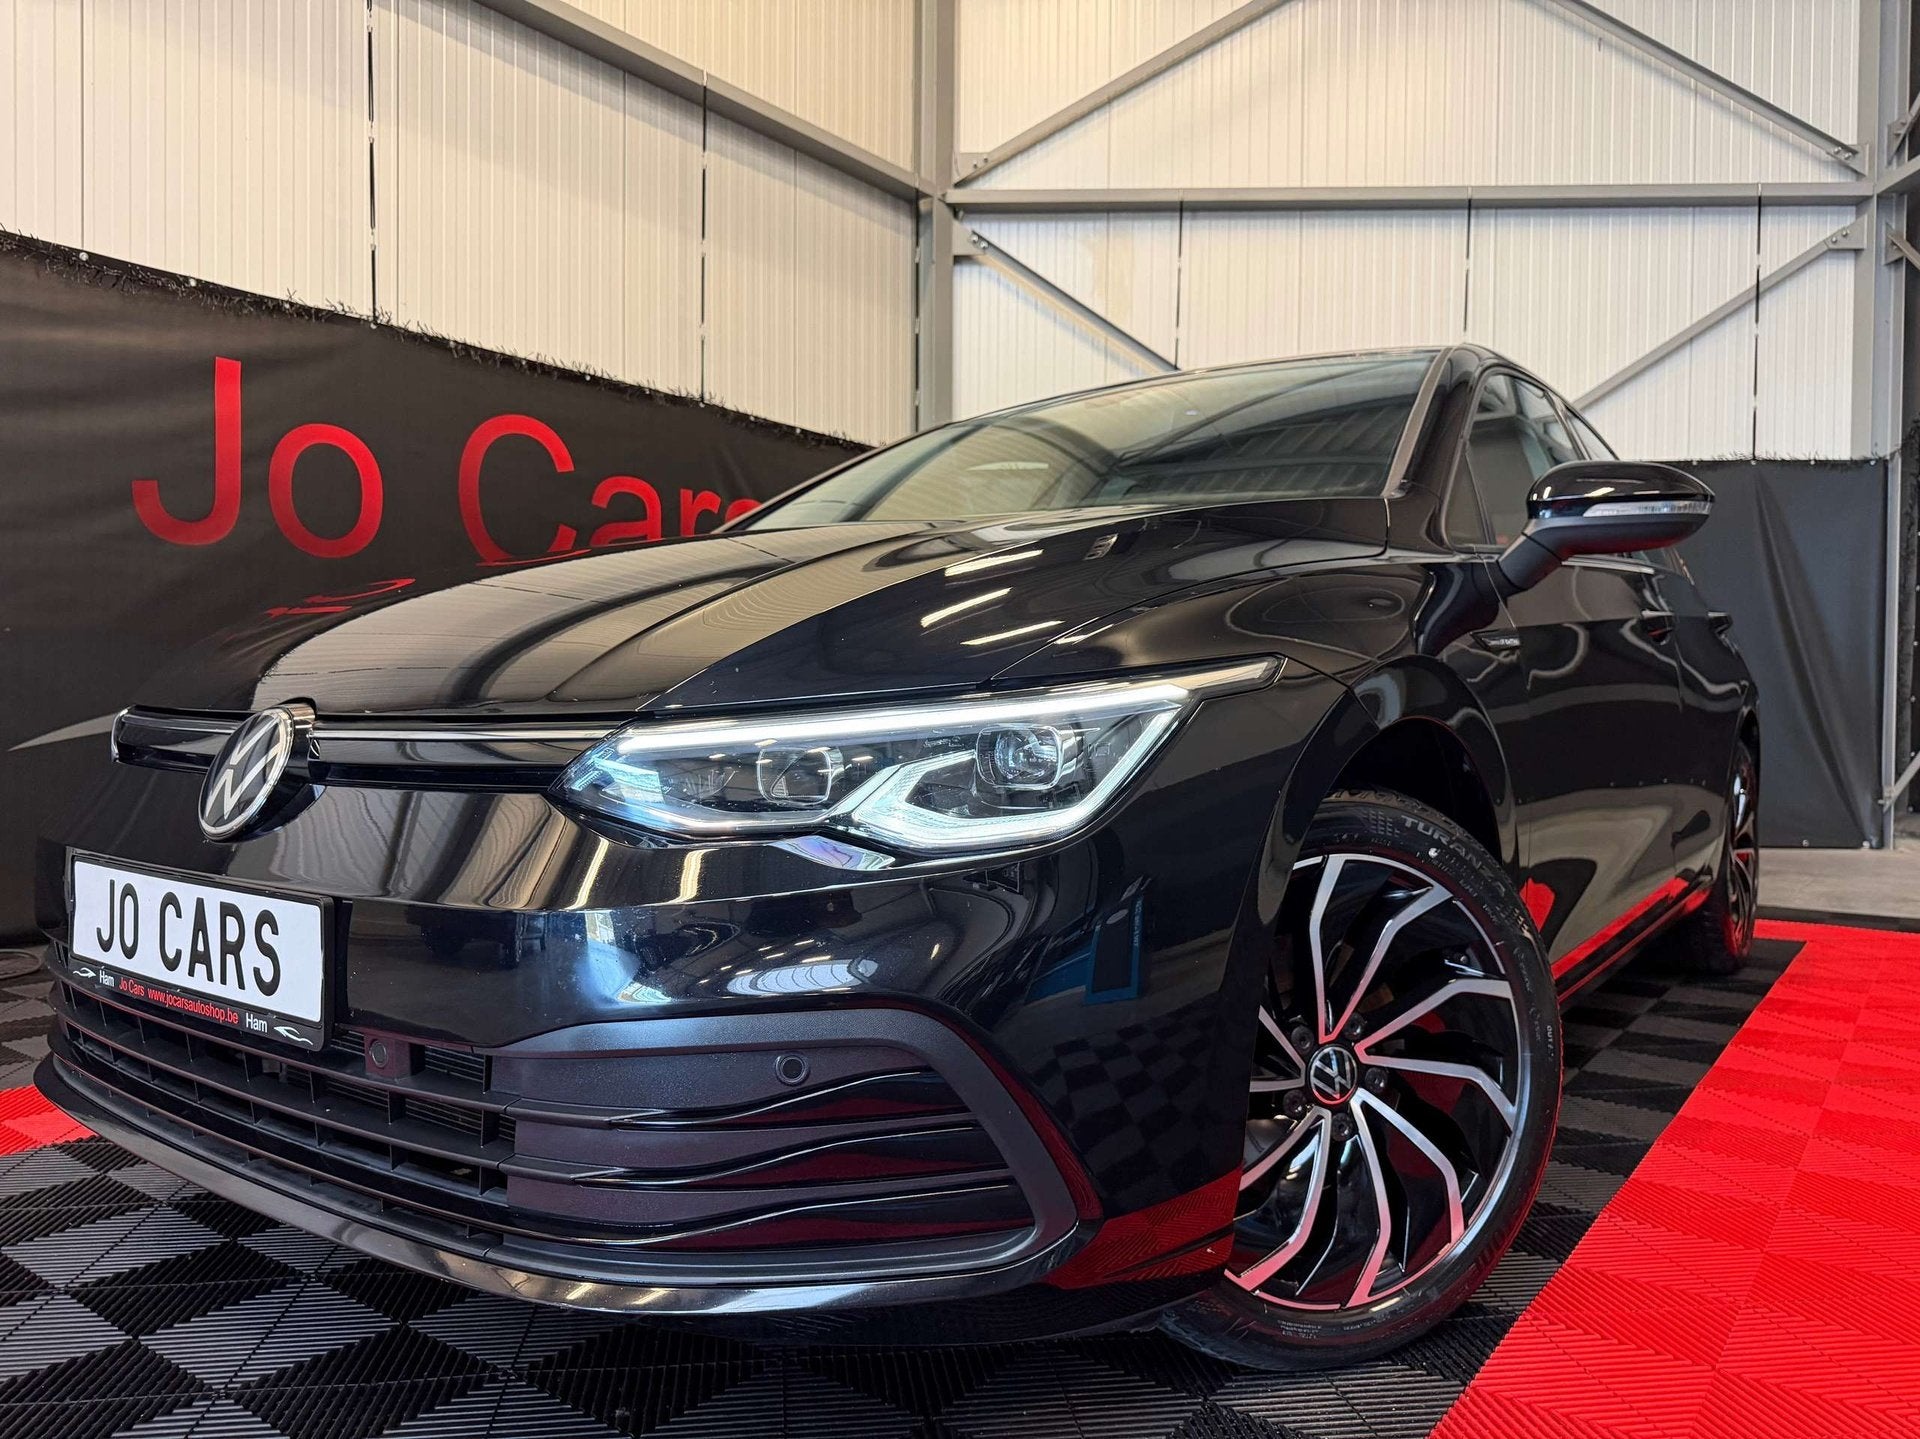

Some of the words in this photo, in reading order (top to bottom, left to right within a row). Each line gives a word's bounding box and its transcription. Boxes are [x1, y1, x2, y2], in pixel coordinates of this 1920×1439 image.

[131, 356, 384, 559] Jo
[96, 878, 139, 960] JO
[158, 891, 281, 997] CARS
[99, 969, 115, 988] Ham
[119, 976, 128, 991] Jo
[128, 978, 145, 997] Cars
[147, 987, 239, 1025] www.jocarsautoshop.be
[245, 1012, 268, 1034] Ham
